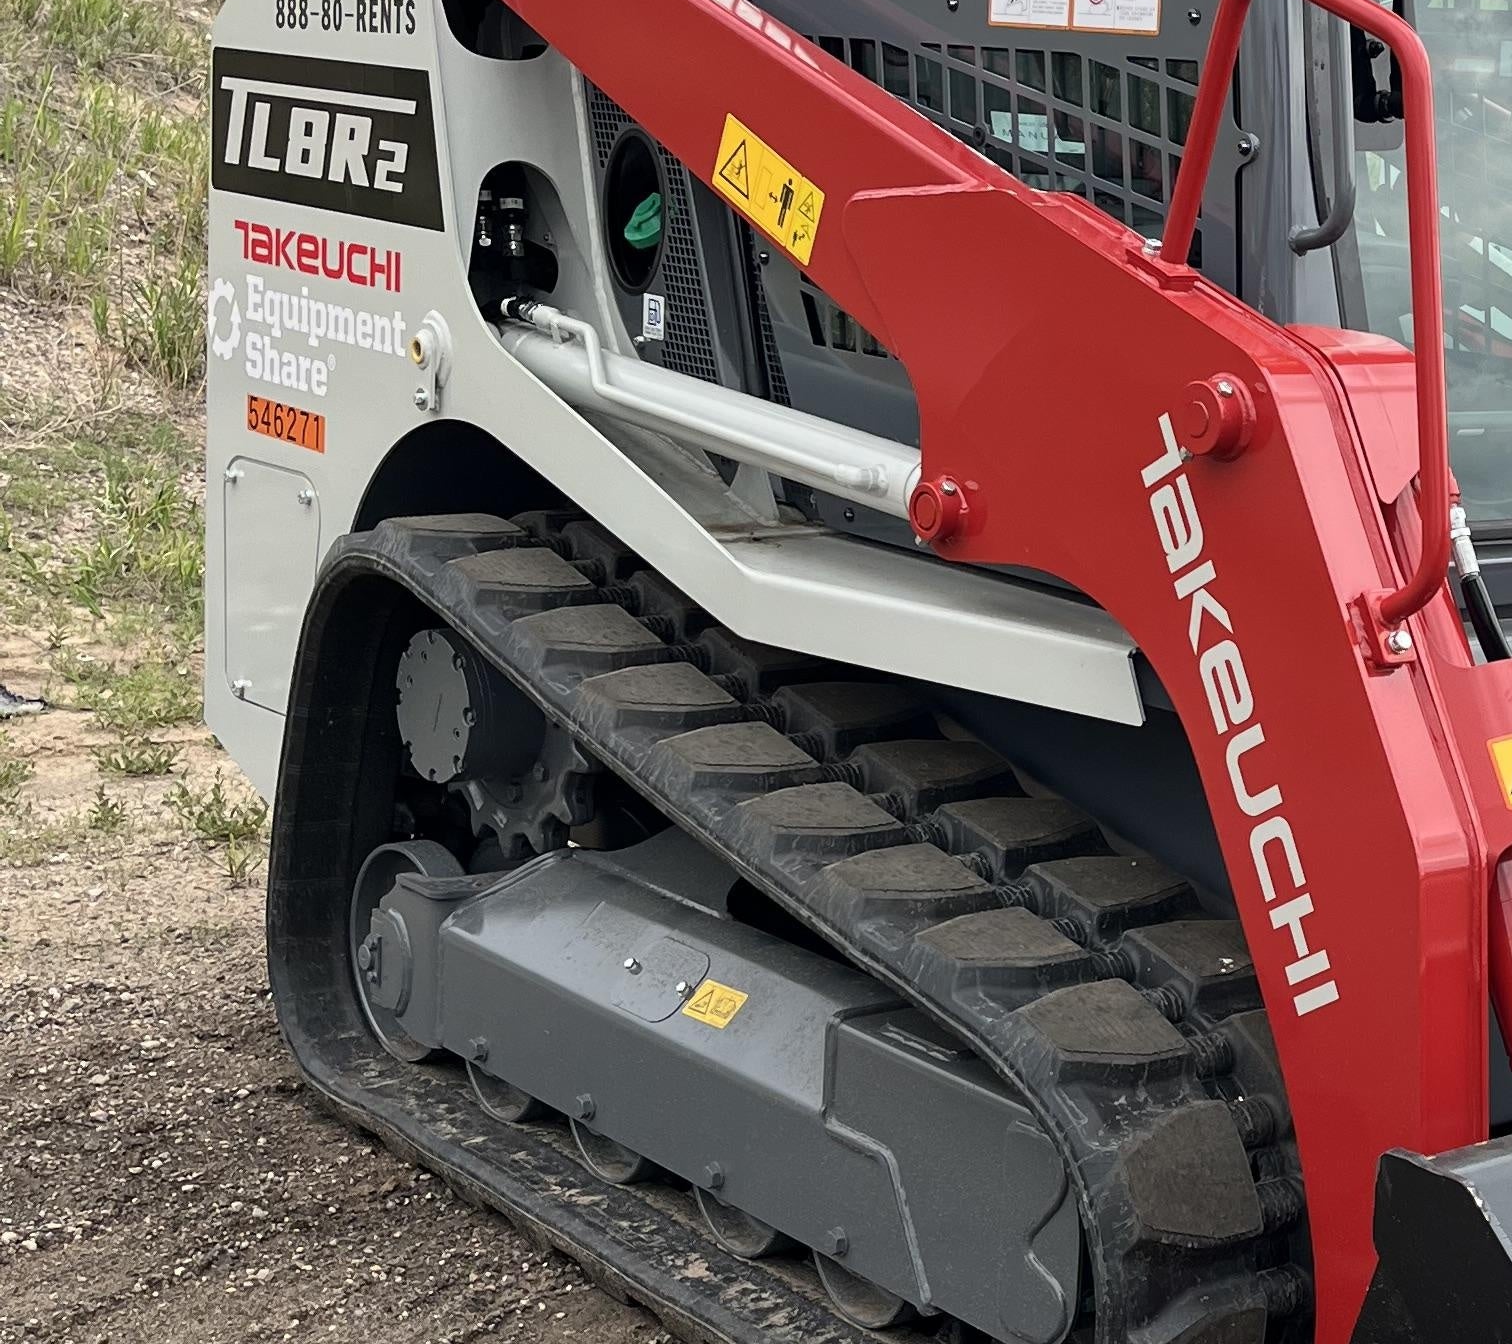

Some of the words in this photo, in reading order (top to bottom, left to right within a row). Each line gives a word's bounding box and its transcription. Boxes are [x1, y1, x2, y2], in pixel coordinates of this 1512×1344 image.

[234, 219, 401, 293] TAKEUCHI
[246, 273, 406, 358] Equipment
[249, 396, 320, 449] 546271
[1140, 412, 1340, 1017] TAKEUCHI
